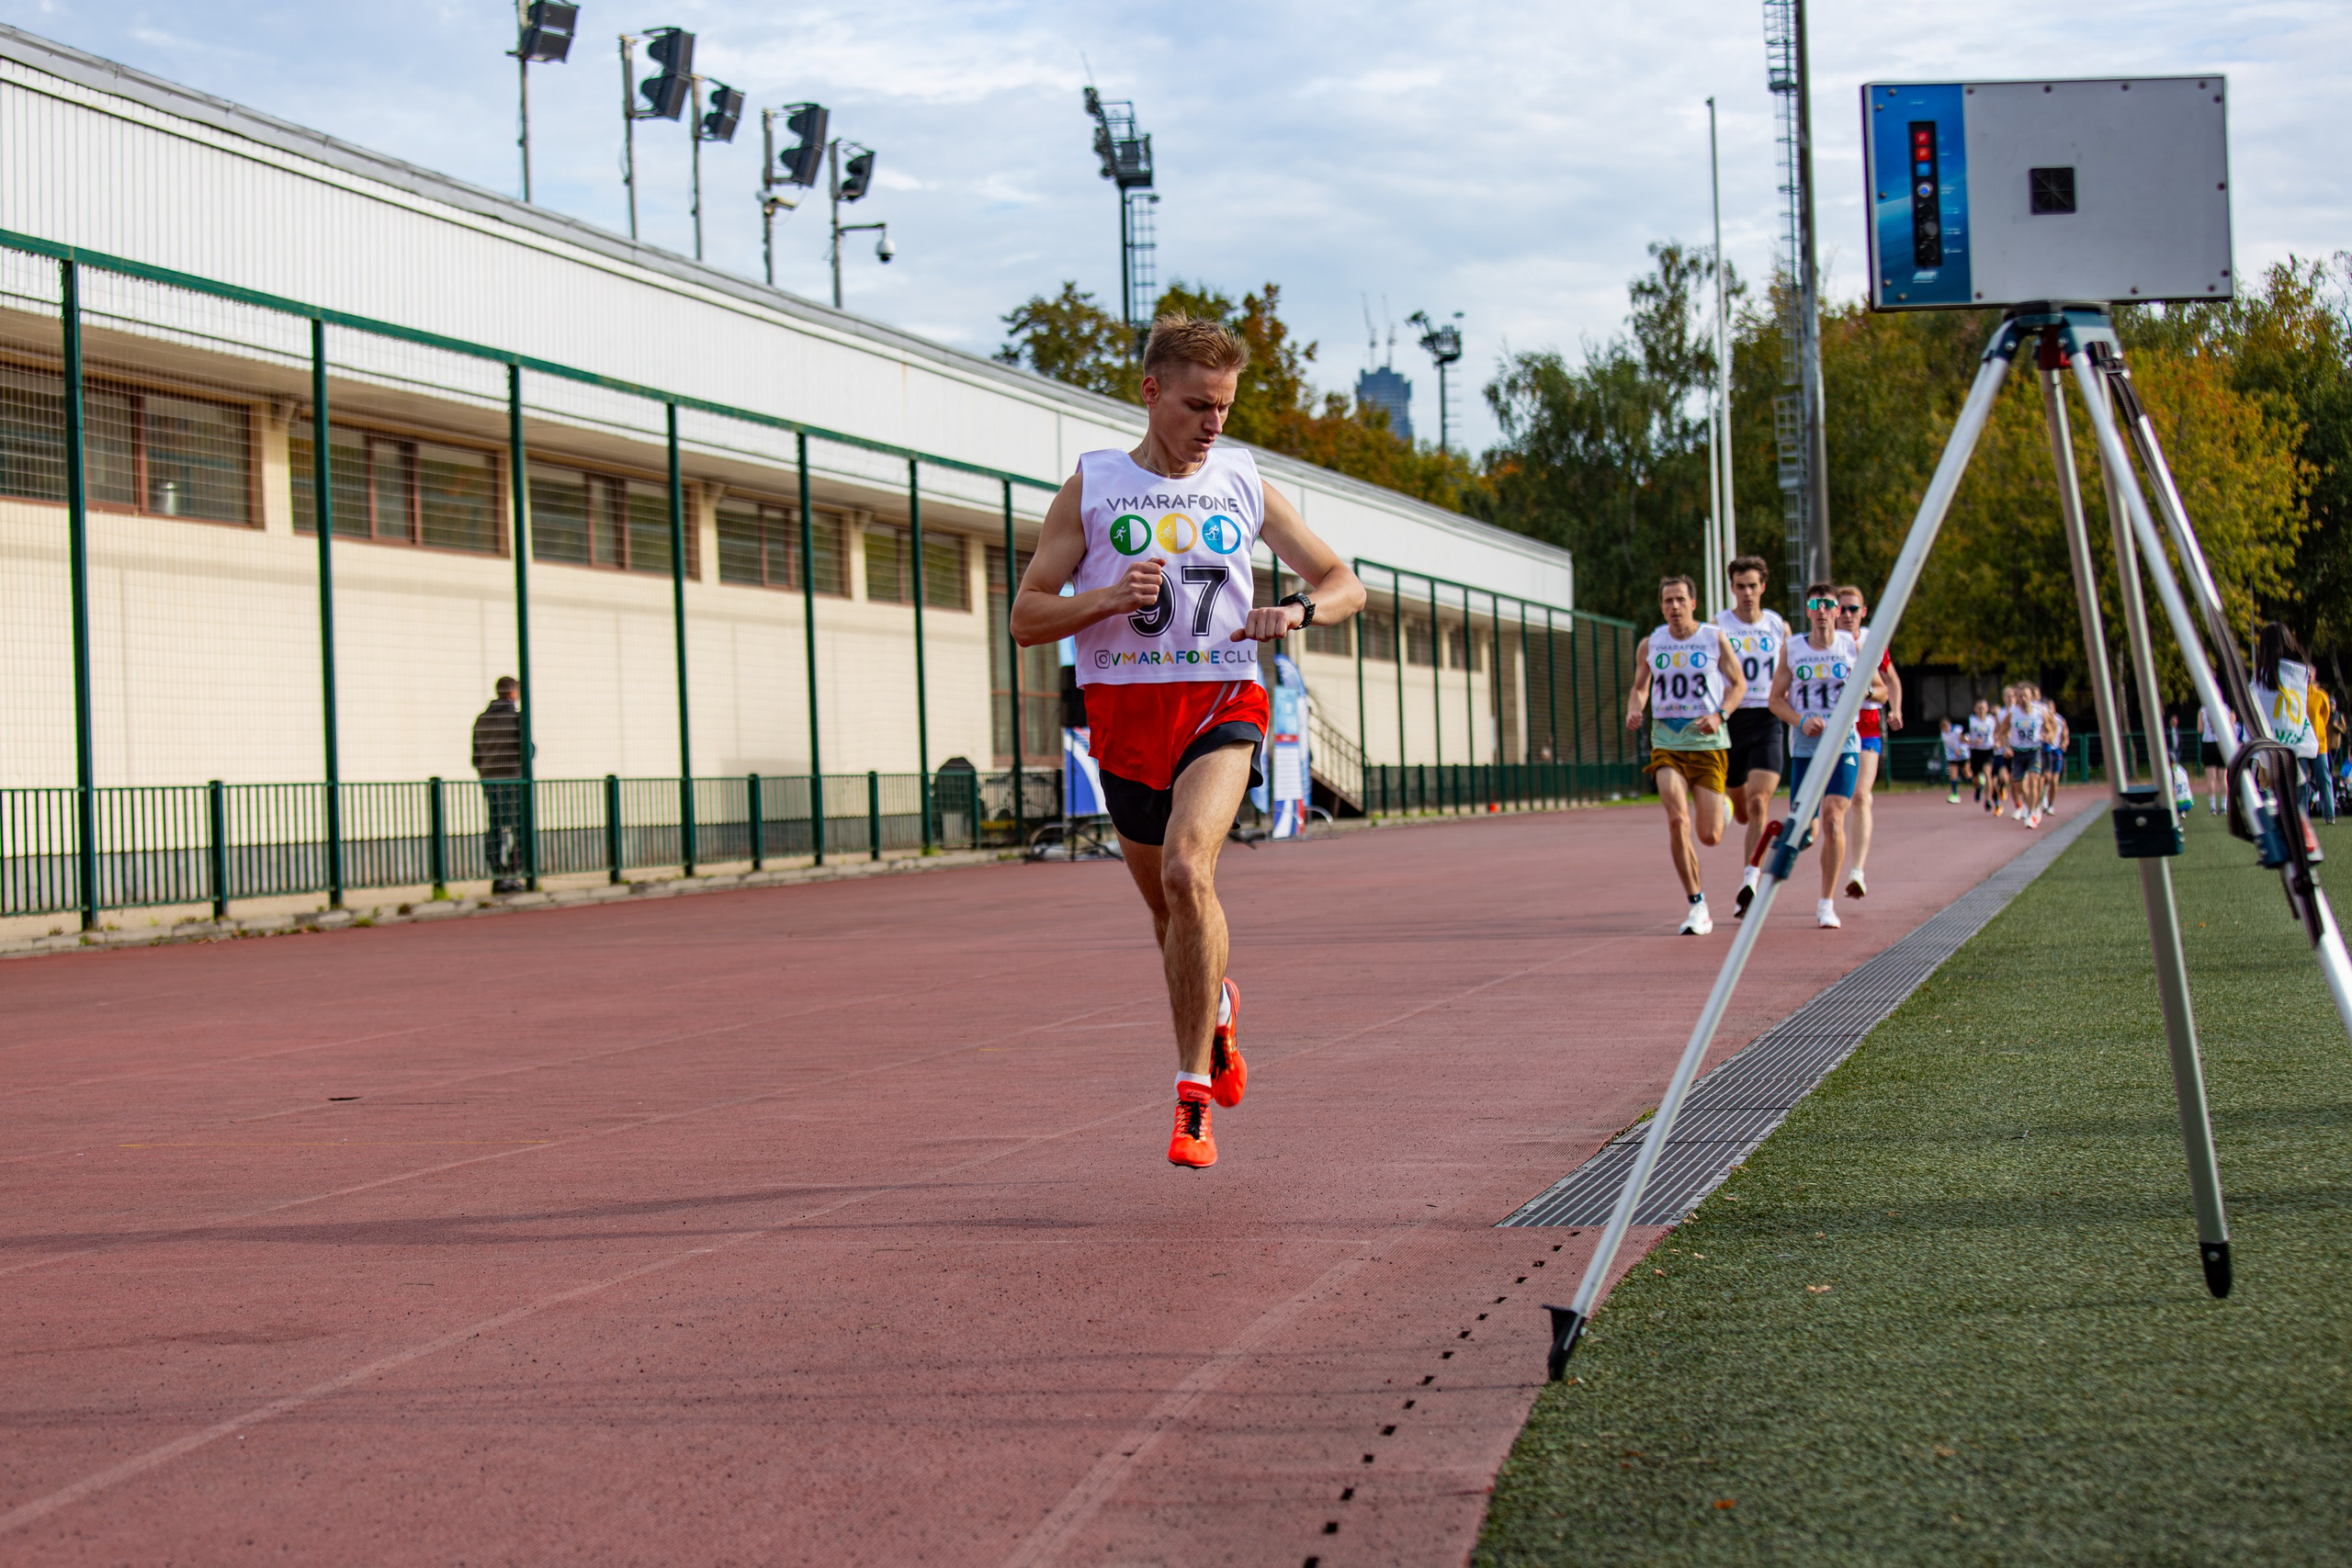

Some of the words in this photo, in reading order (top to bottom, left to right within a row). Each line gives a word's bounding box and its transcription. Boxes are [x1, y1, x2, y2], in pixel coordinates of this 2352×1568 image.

[1106, 494, 1239, 513] VMARAFONE
[1127, 566, 1229, 637] 97
[1743, 657, 1775, 682] 01
[1794, 655, 1848, 665] VMARAFONE
[1656, 672, 1707, 701] 103
